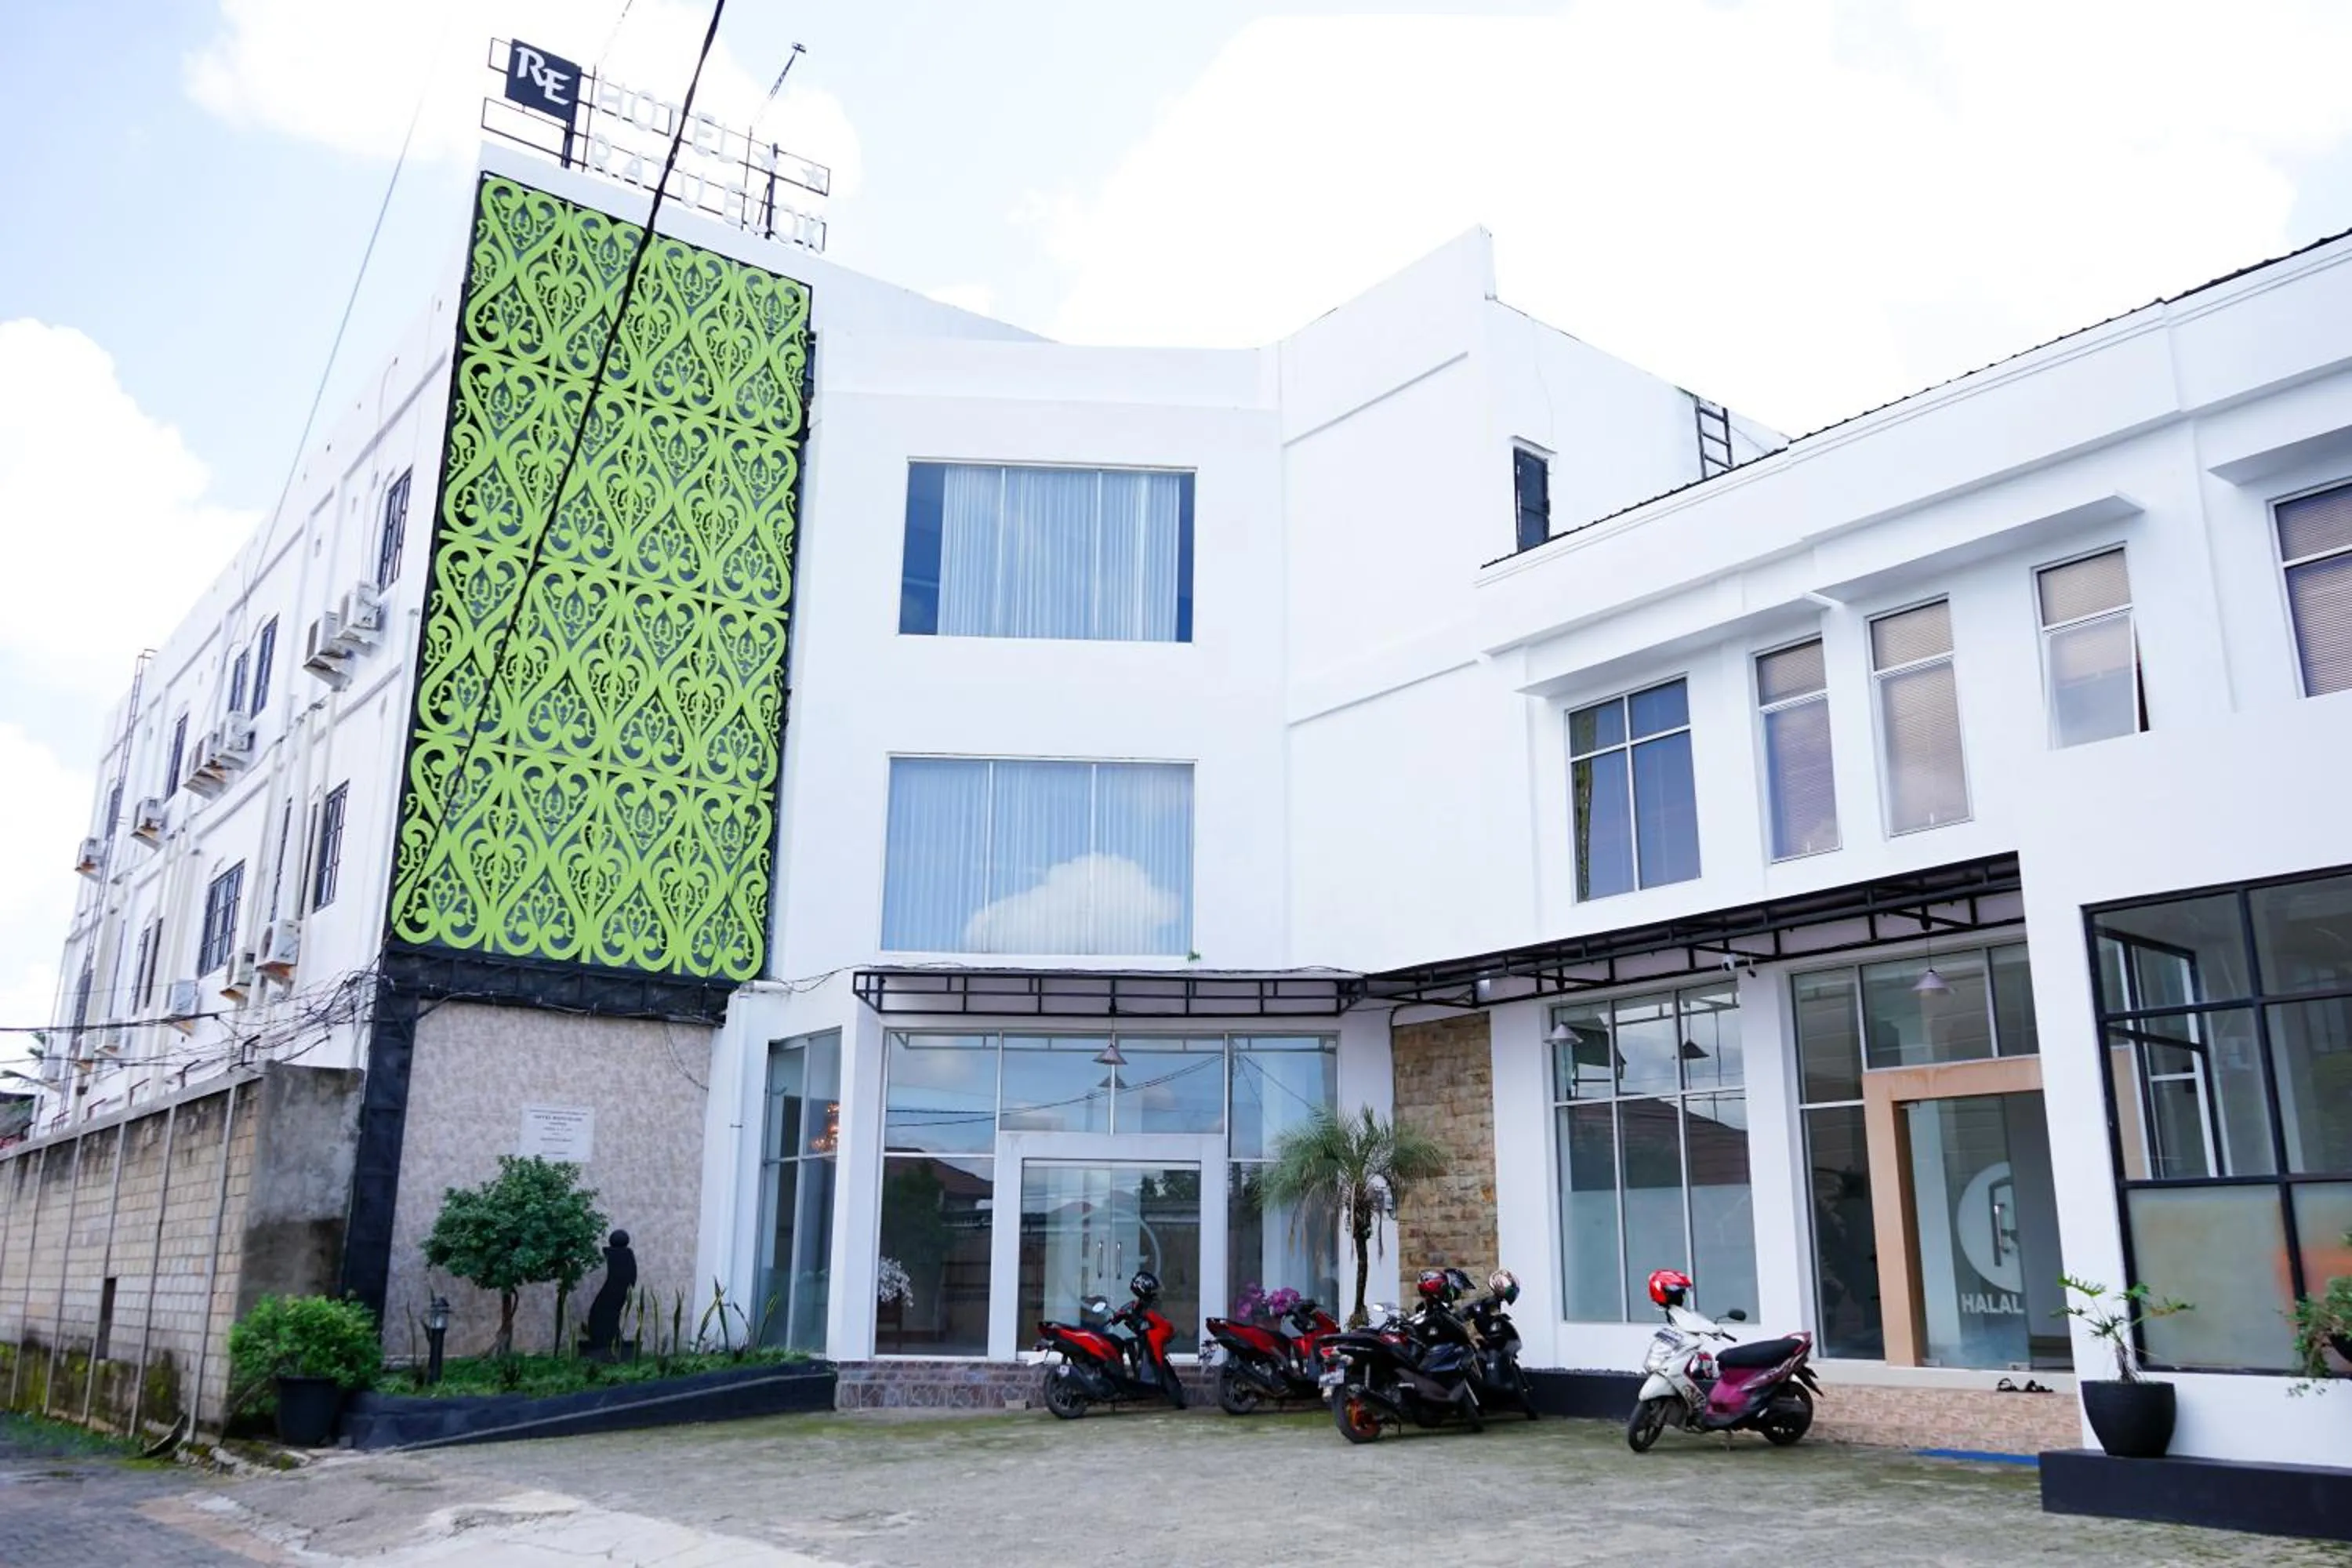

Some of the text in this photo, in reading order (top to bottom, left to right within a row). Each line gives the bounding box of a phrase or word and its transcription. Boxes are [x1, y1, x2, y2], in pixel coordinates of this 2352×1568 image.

[514, 46, 572, 105] RE
[598, 75, 738, 164] HOTEL
[723, 180, 826, 255] ELOK
[1962, 1294, 2024, 1314] HALAL
